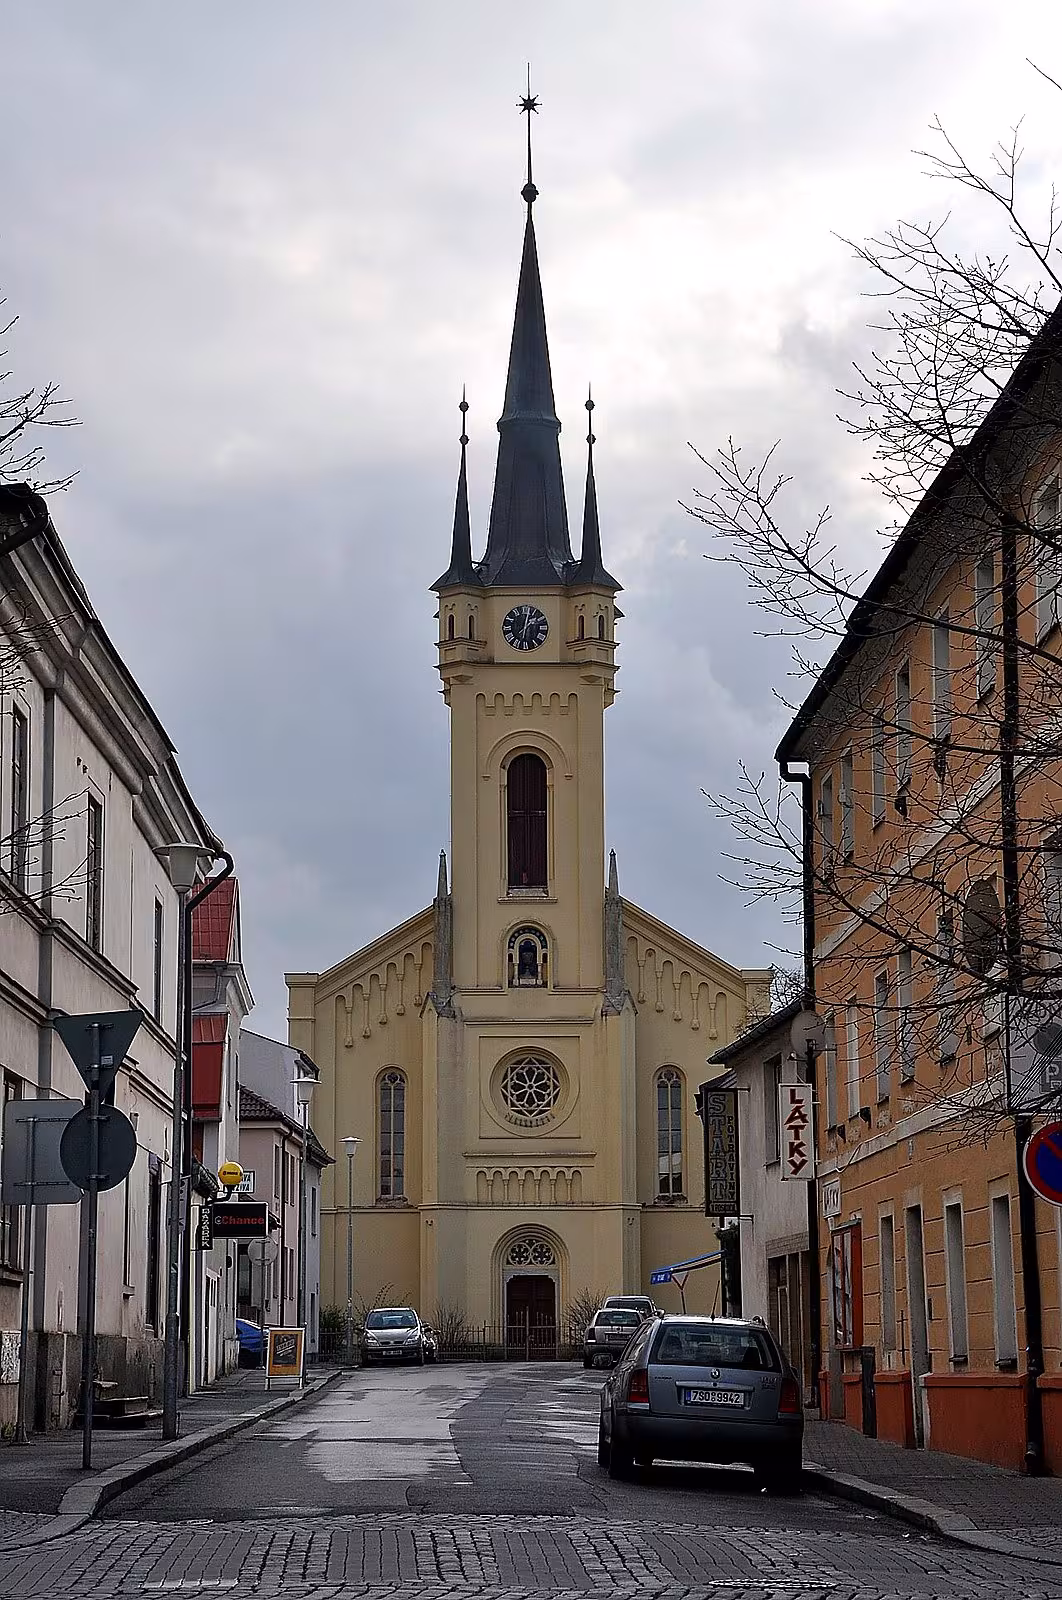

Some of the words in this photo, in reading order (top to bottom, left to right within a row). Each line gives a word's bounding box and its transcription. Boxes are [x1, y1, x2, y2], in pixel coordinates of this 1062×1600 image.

[708, 1094, 728, 1200] START
[727, 1115, 736, 1198] POTRAVINY
[784, 1088, 810, 1176] LÁTKY
[221, 1216, 264, 1224] Chance
